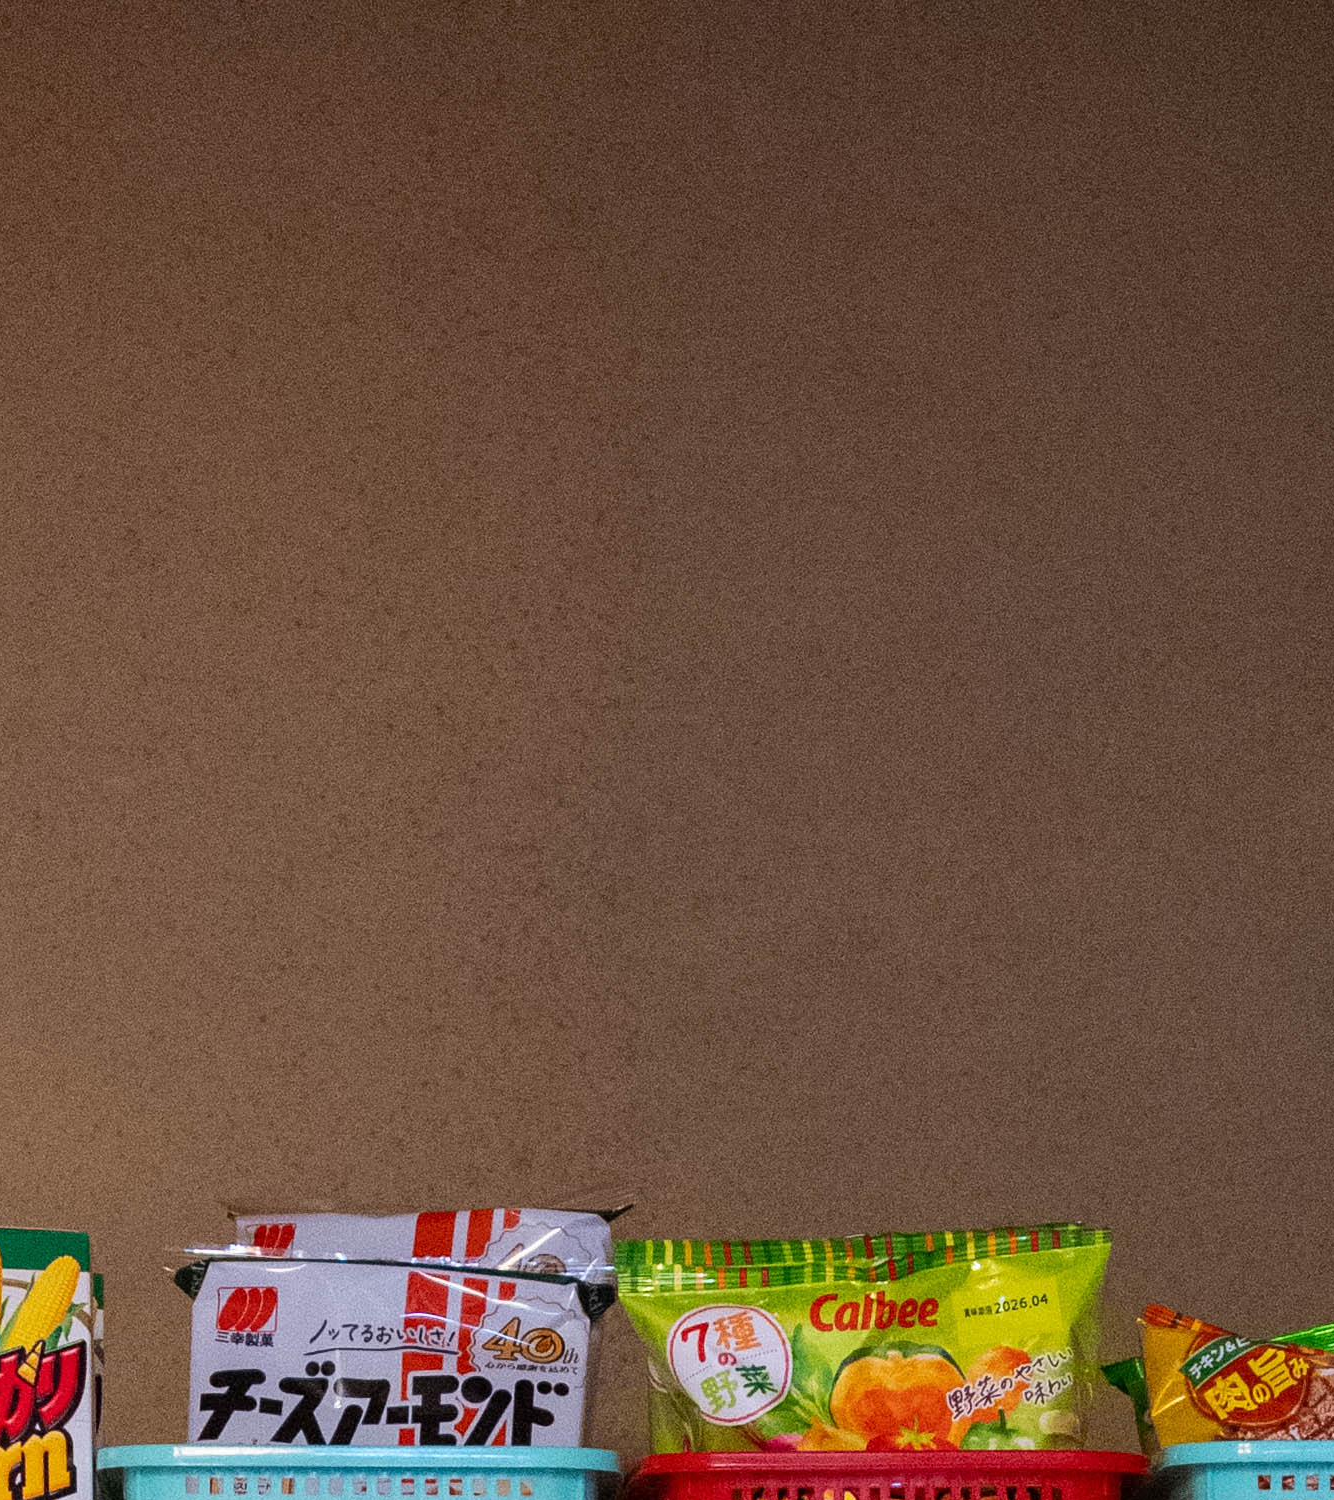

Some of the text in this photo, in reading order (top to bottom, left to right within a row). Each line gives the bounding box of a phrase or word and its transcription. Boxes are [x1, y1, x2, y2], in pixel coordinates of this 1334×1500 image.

[810, 1292, 939, 1332] Calbee
[994, 1293, 1049, 1315] 2026.04
[215, 1332, 274, 1348] 三幸製菓
[309, 1319, 457, 1348] ノッてるおいしさ!
[199, 1361, 569, 1446] チーズアーモンド
[1023, 1375, 1073, 1405] 味わい
